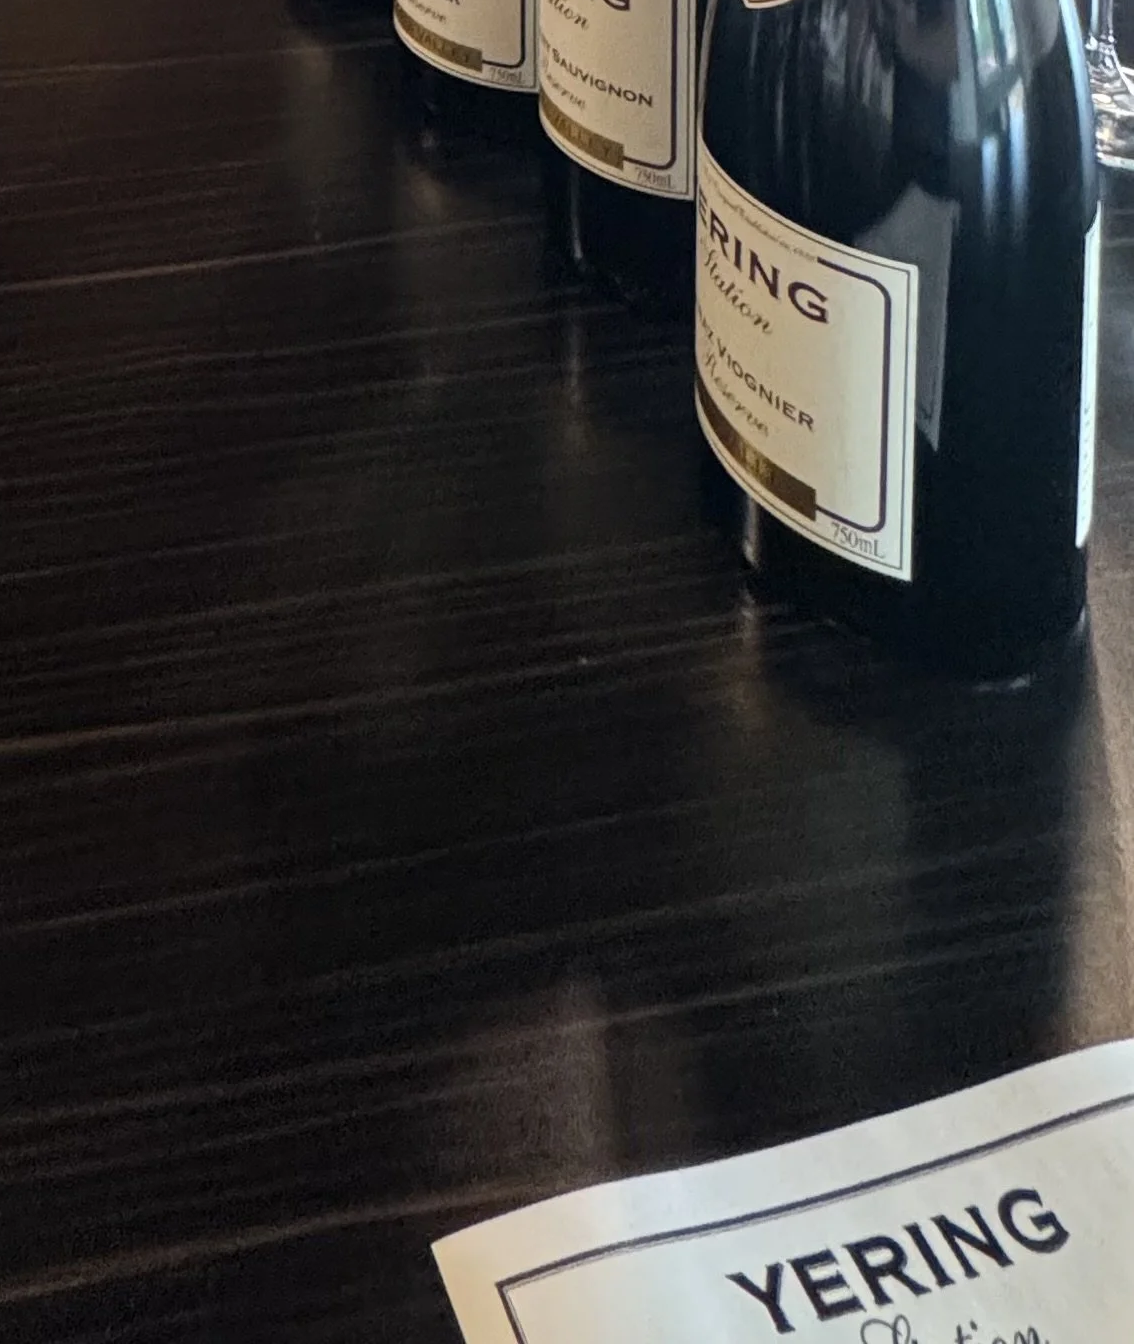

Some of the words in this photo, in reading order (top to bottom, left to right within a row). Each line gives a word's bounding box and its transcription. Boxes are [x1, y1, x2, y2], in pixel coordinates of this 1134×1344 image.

[552, 47, 654, 109] SAUVIGNON
[698, 184, 829, 325] ERING
[716, 337, 815, 433] VIOGNIER
[830, 522, 886, 560] 750mL
[725, 1188, 1070, 1335] YERING
